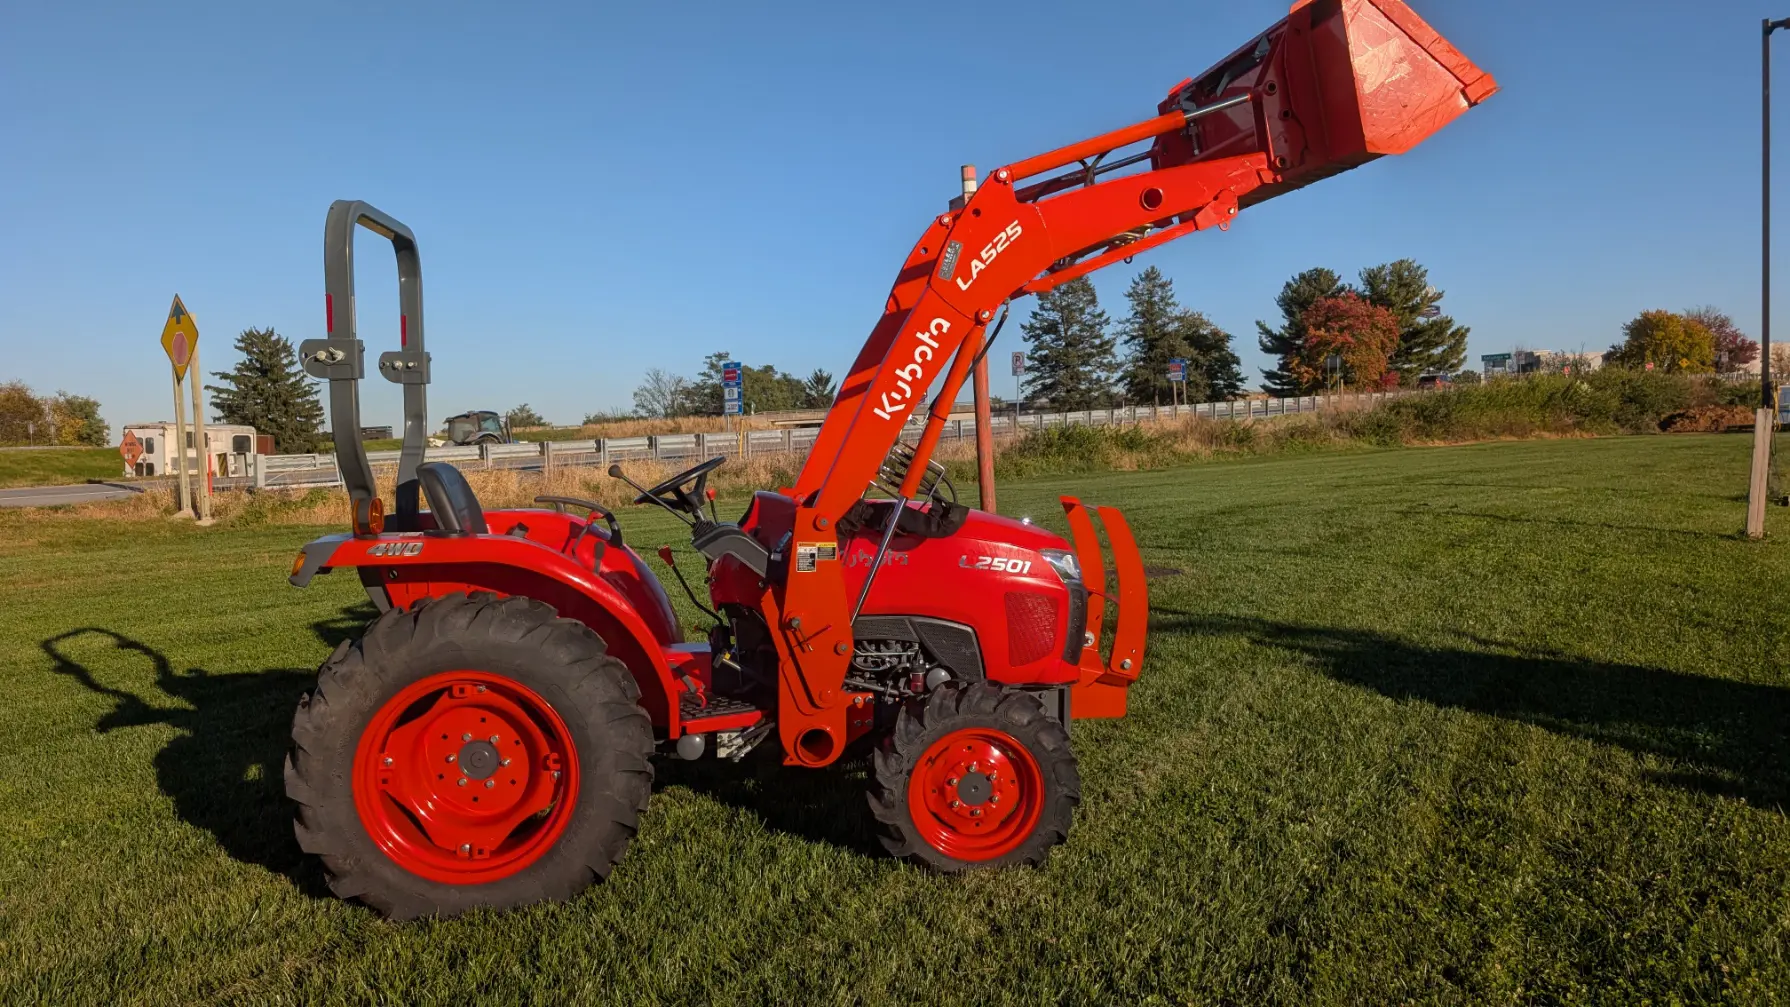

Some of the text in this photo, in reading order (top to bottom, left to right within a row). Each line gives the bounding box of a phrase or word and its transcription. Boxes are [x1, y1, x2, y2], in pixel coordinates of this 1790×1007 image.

[956, 219, 1022, 291] LA525
[873, 317, 951, 421] Kubota
[366, 542, 424, 557] 4WD
[959, 555, 1032, 575] L2501
